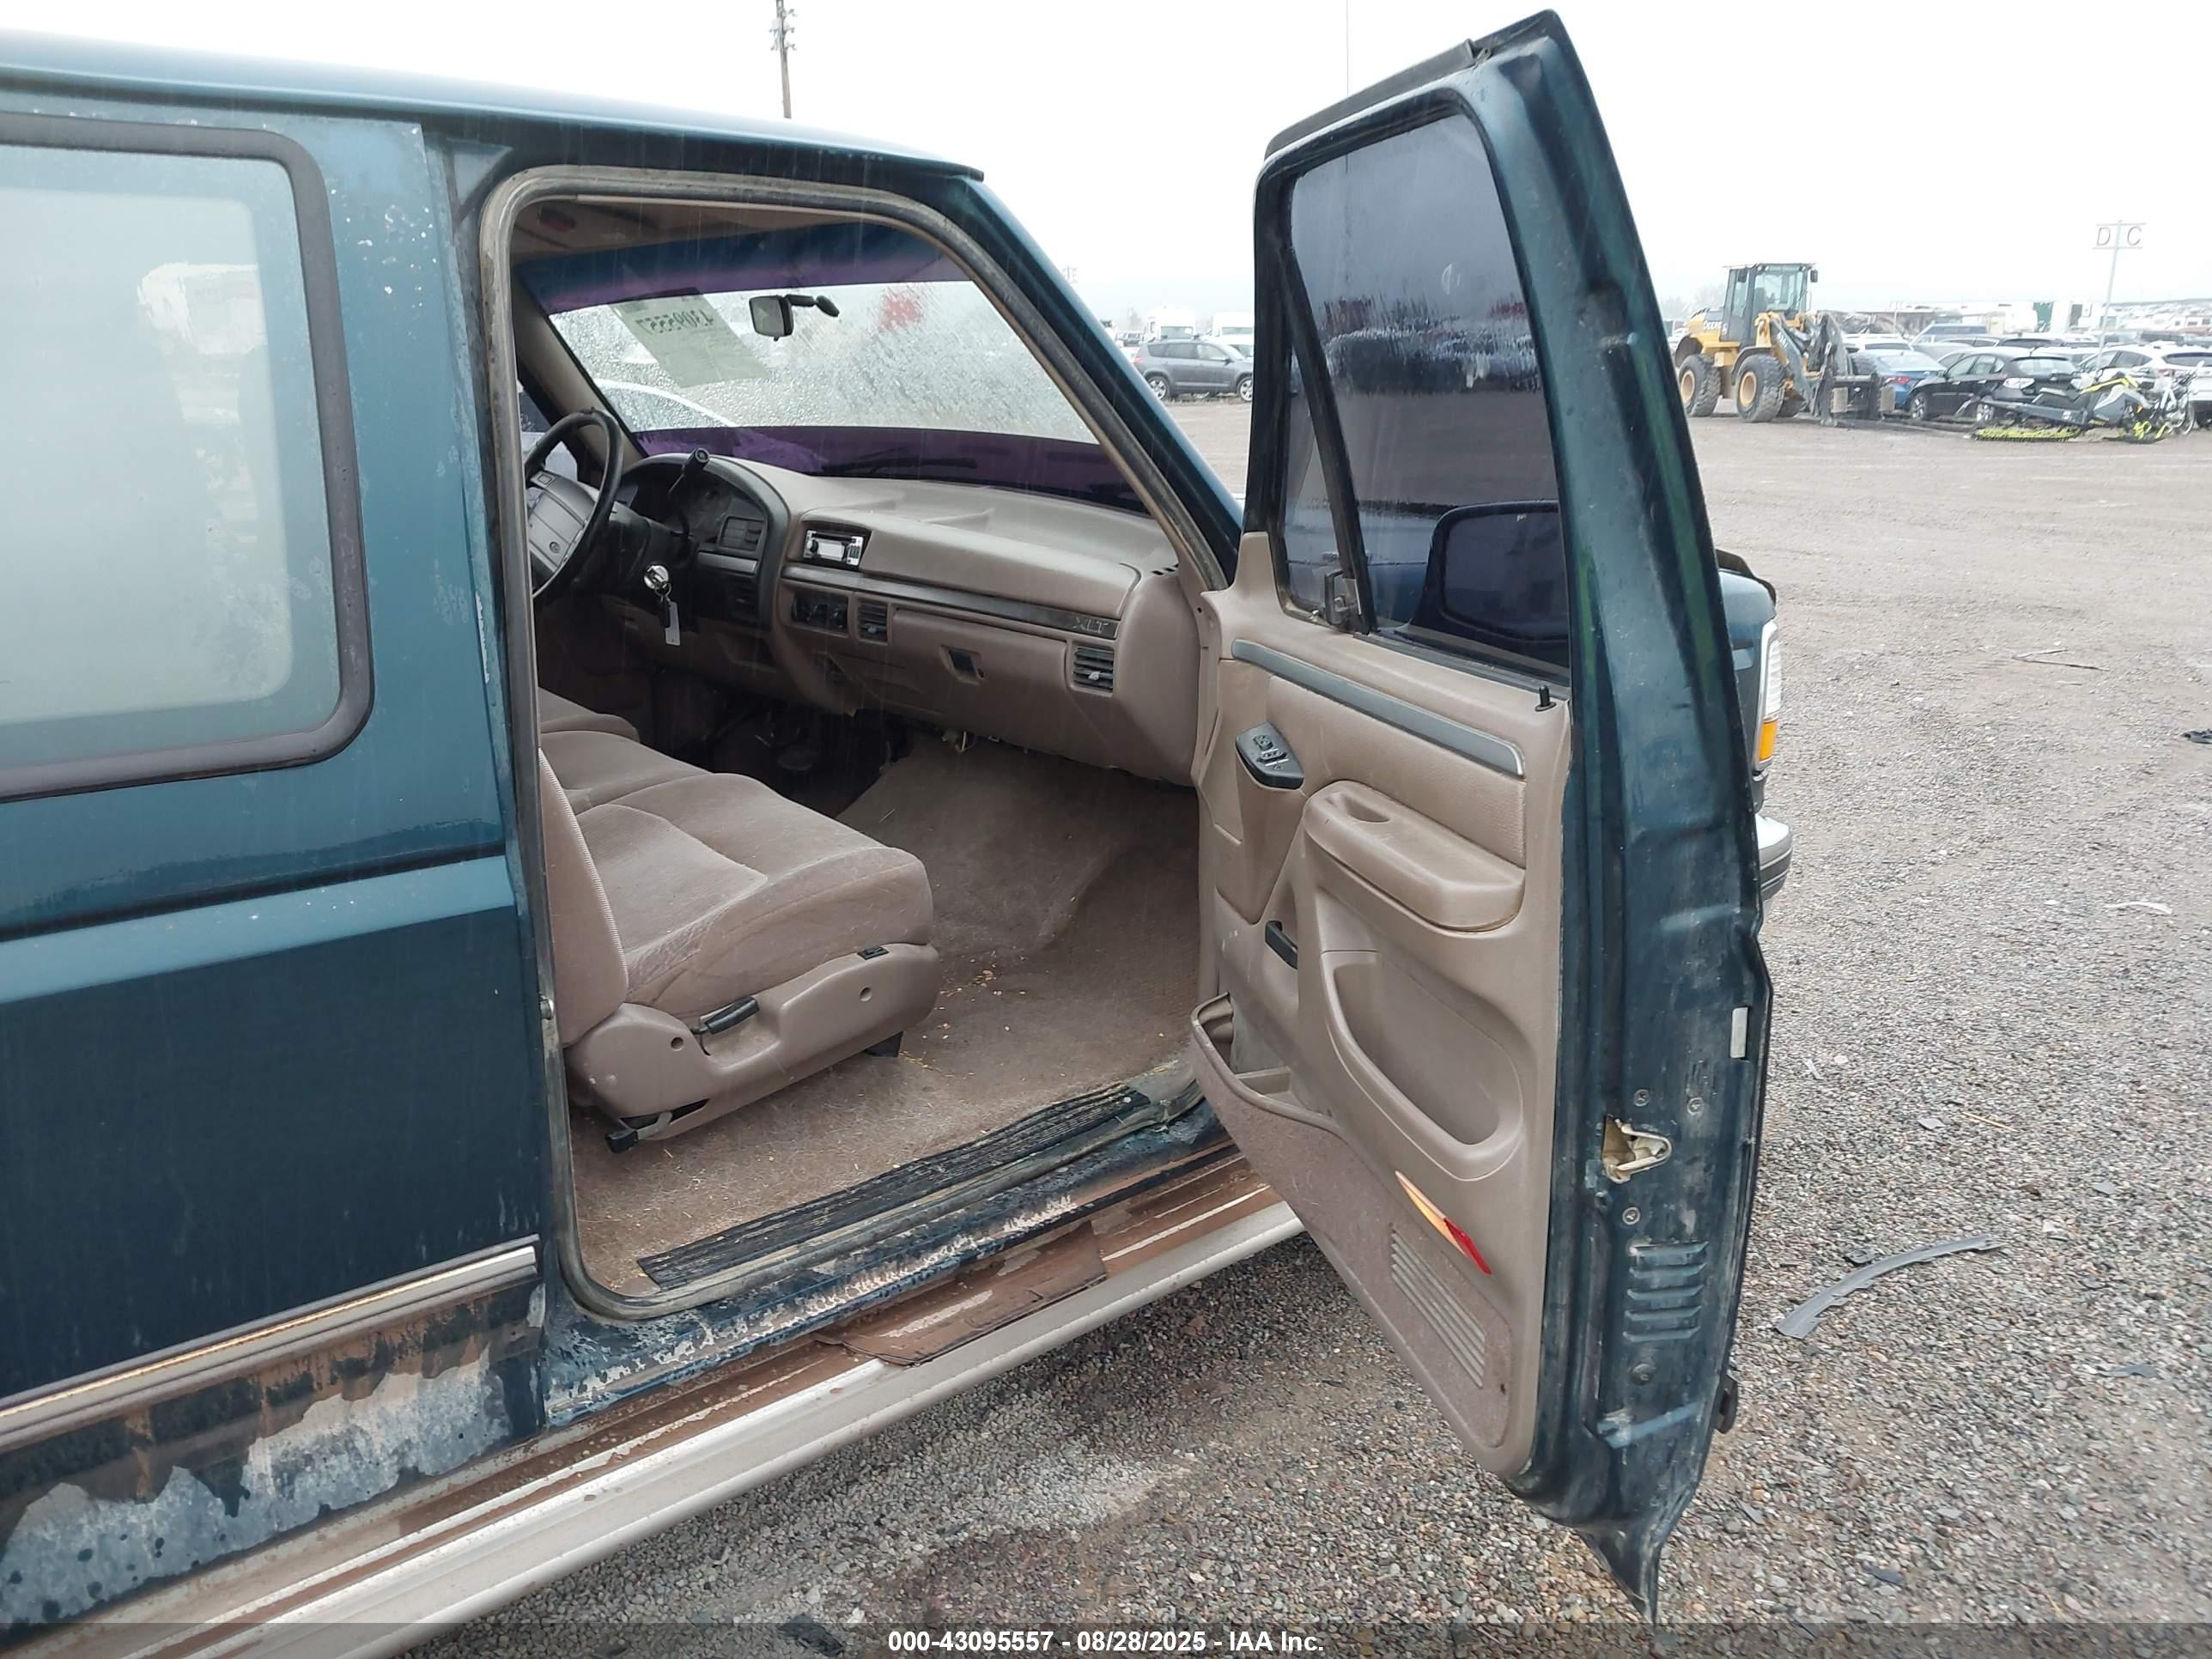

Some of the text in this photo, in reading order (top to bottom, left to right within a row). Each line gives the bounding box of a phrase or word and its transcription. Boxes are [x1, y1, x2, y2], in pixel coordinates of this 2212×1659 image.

[2096, 226, 2142, 246] D C
[1073, 616, 1109, 634] XLT
